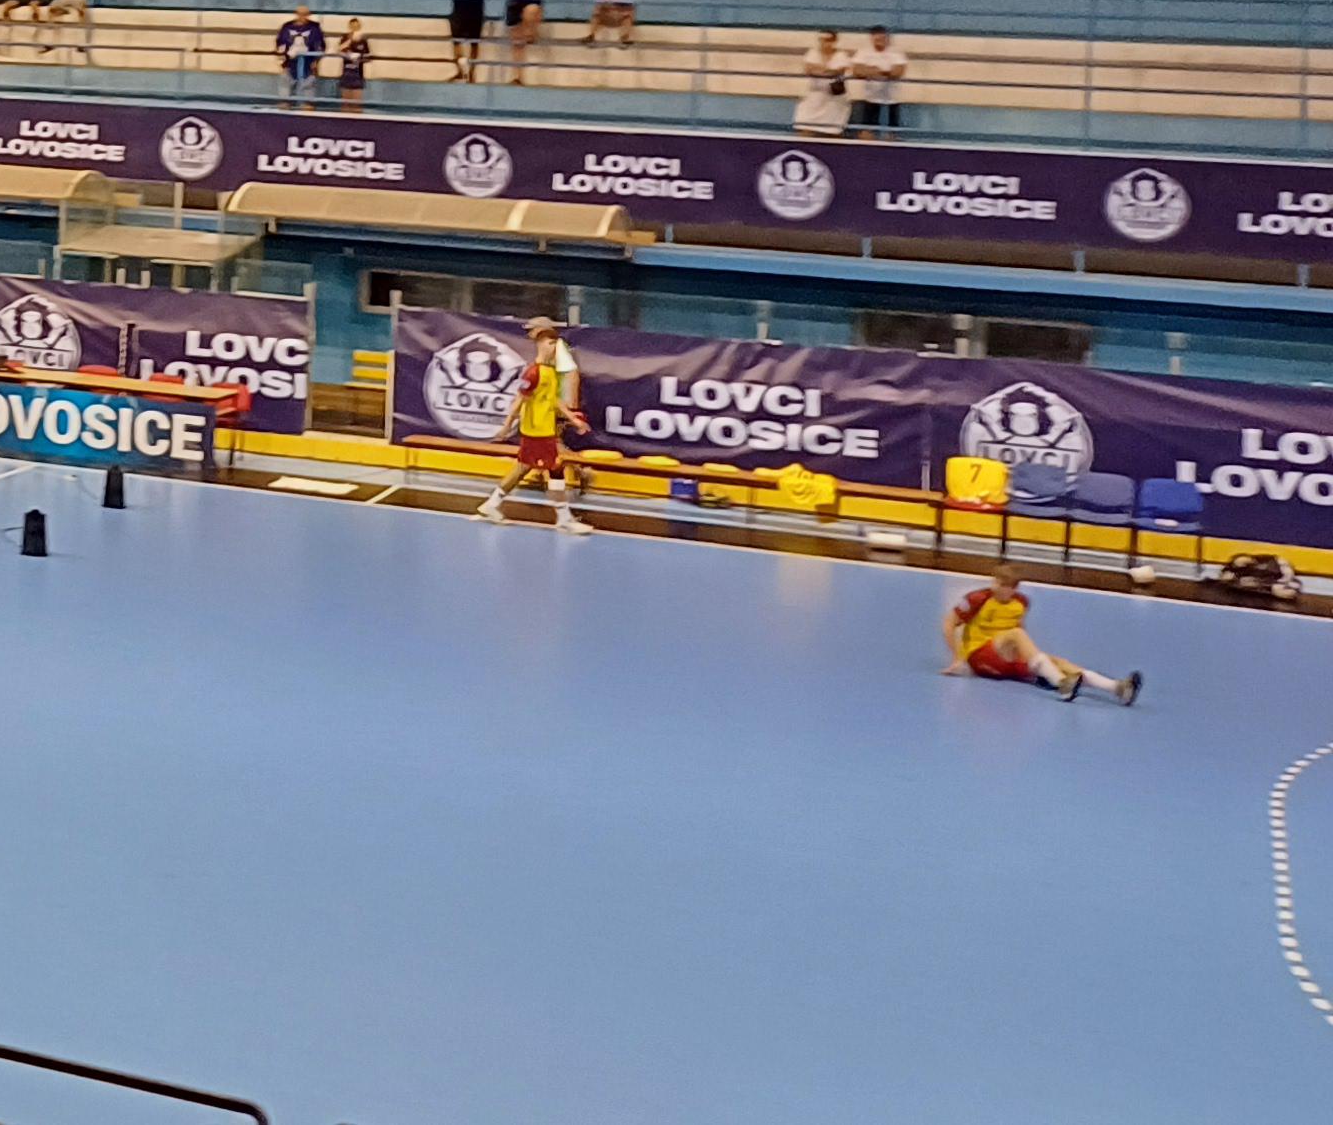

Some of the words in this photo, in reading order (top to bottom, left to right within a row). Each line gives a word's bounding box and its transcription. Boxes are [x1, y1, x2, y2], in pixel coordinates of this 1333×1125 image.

[19, 119, 99, 141] LOVCI
[287, 136, 375, 159] LOVCI
[257, 154, 406, 181] LOVOSICE
[584, 153, 681, 177] LOVCI
[552, 173, 714, 200] LOVOSICE
[913, 171, 1020, 196] LOVCI
[875, 191, 1057, 220] LOVOSICE
[659, 376, 823, 417] LOVCI
[605, 406, 880, 459] LOVOSICE
